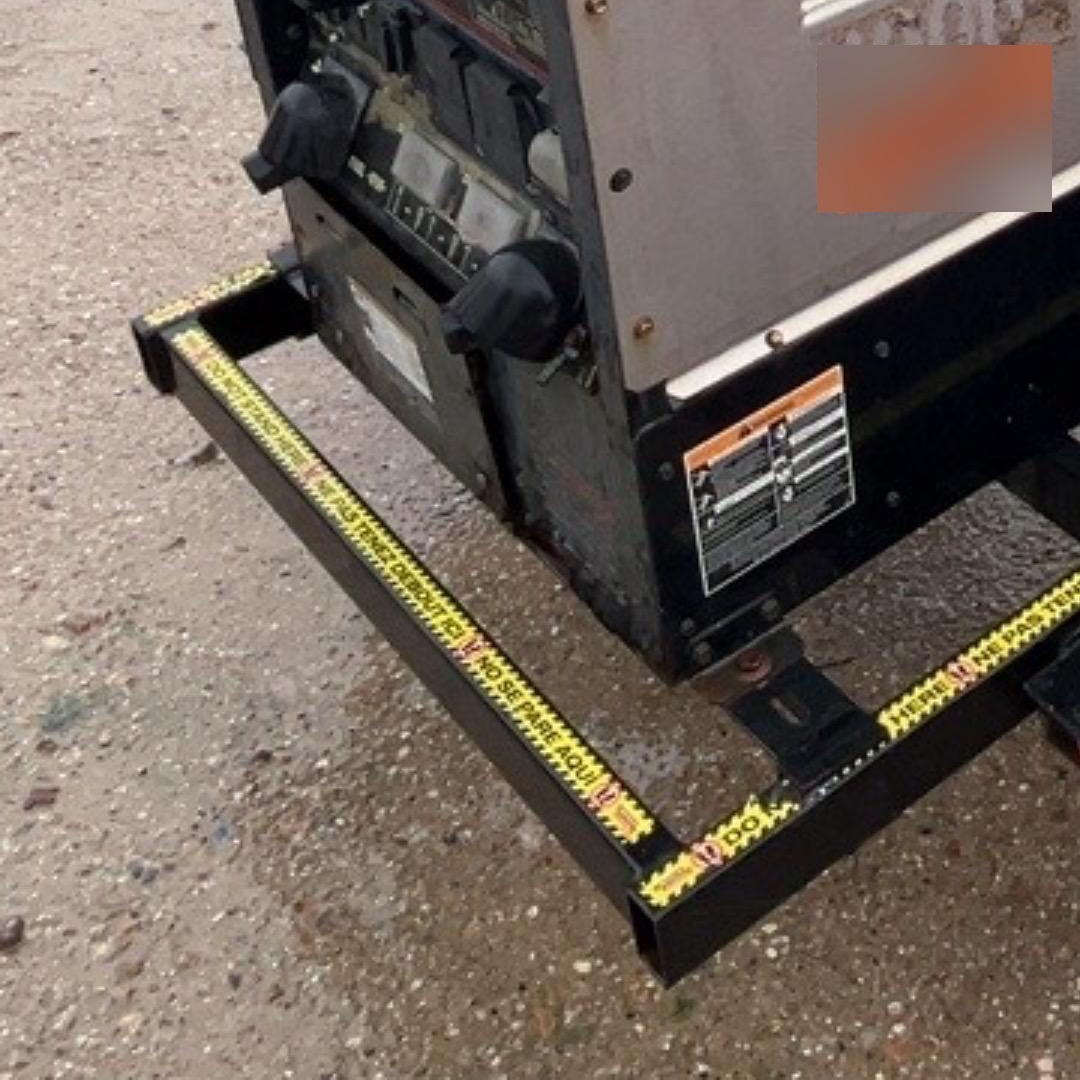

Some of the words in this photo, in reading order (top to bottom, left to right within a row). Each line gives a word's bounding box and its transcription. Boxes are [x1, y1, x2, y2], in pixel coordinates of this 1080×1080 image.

[476, 656, 501, 682] NO
[499, 678, 523, 701] SE
[519, 701, 561, 746] PARE
[556, 744, 598, 787] AQUI
